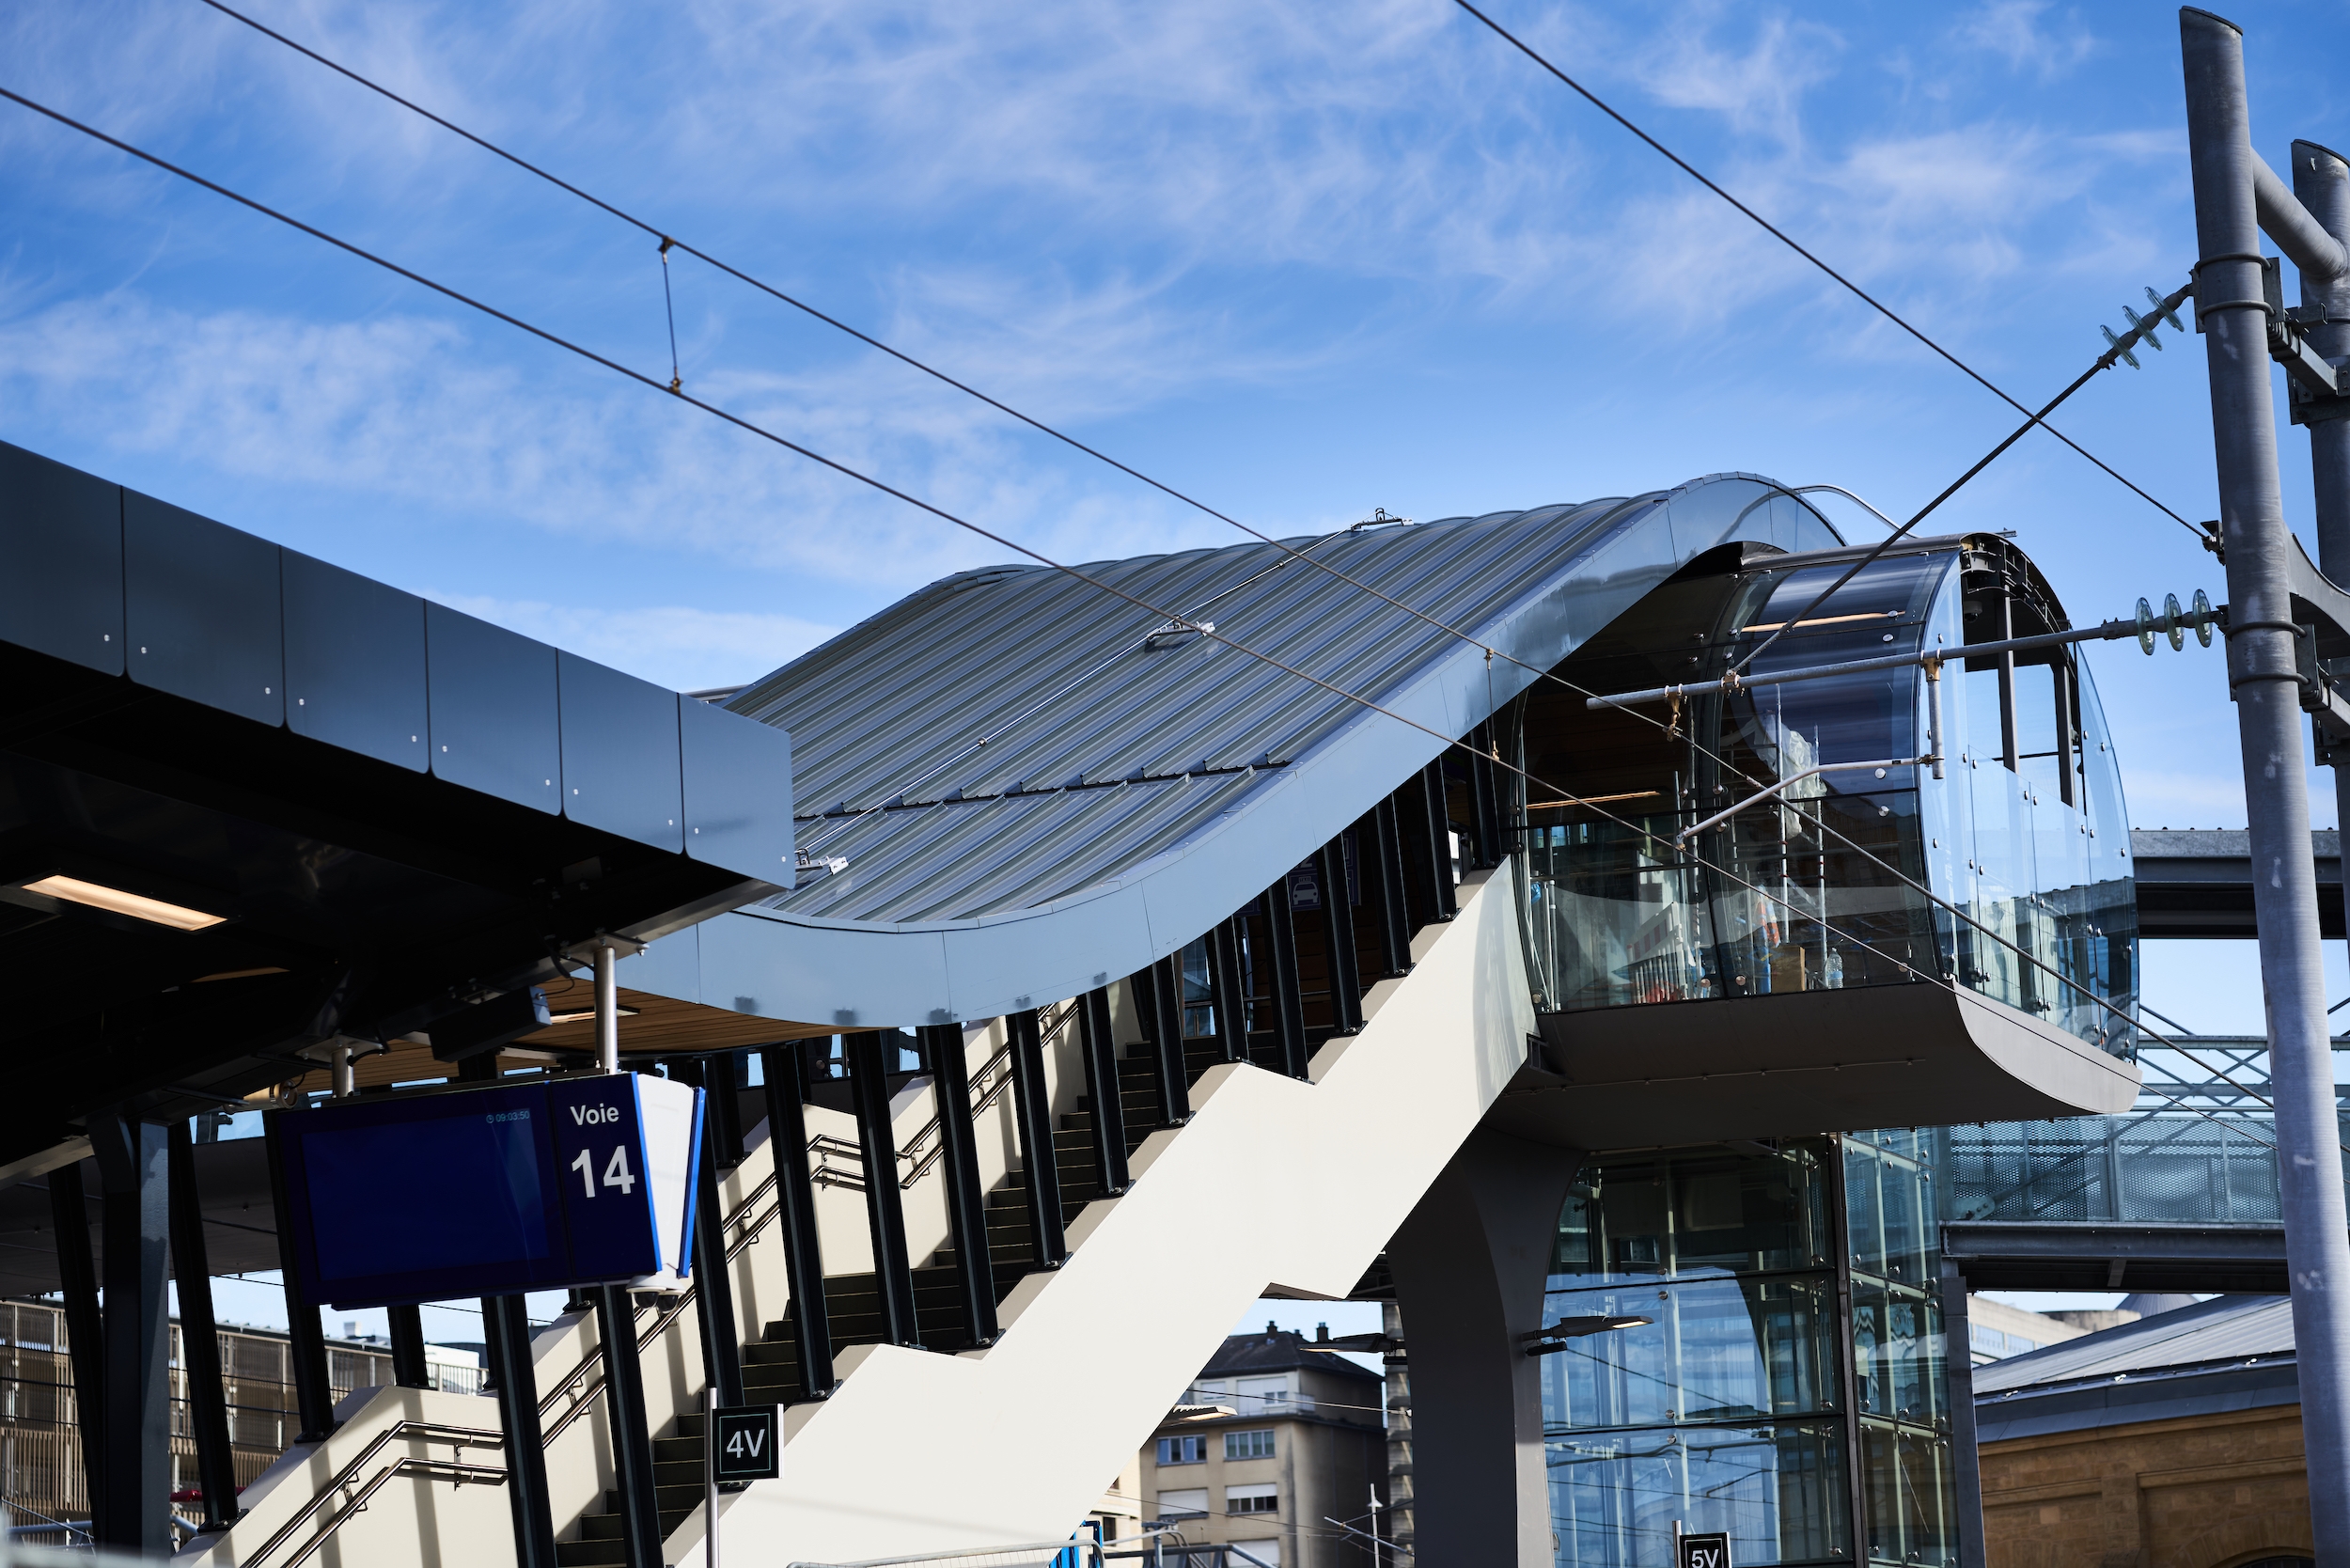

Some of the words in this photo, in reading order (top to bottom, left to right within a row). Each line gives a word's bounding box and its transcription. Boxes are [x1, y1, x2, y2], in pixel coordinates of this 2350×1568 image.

[495, 1110, 530, 1122] 09:03:50
[570, 1103, 619, 1125] Voie
[572, 1145, 635, 1198] 14
[726, 1429, 765, 1459] 4V
[1692, 1548, 1719, 1568] 5V
